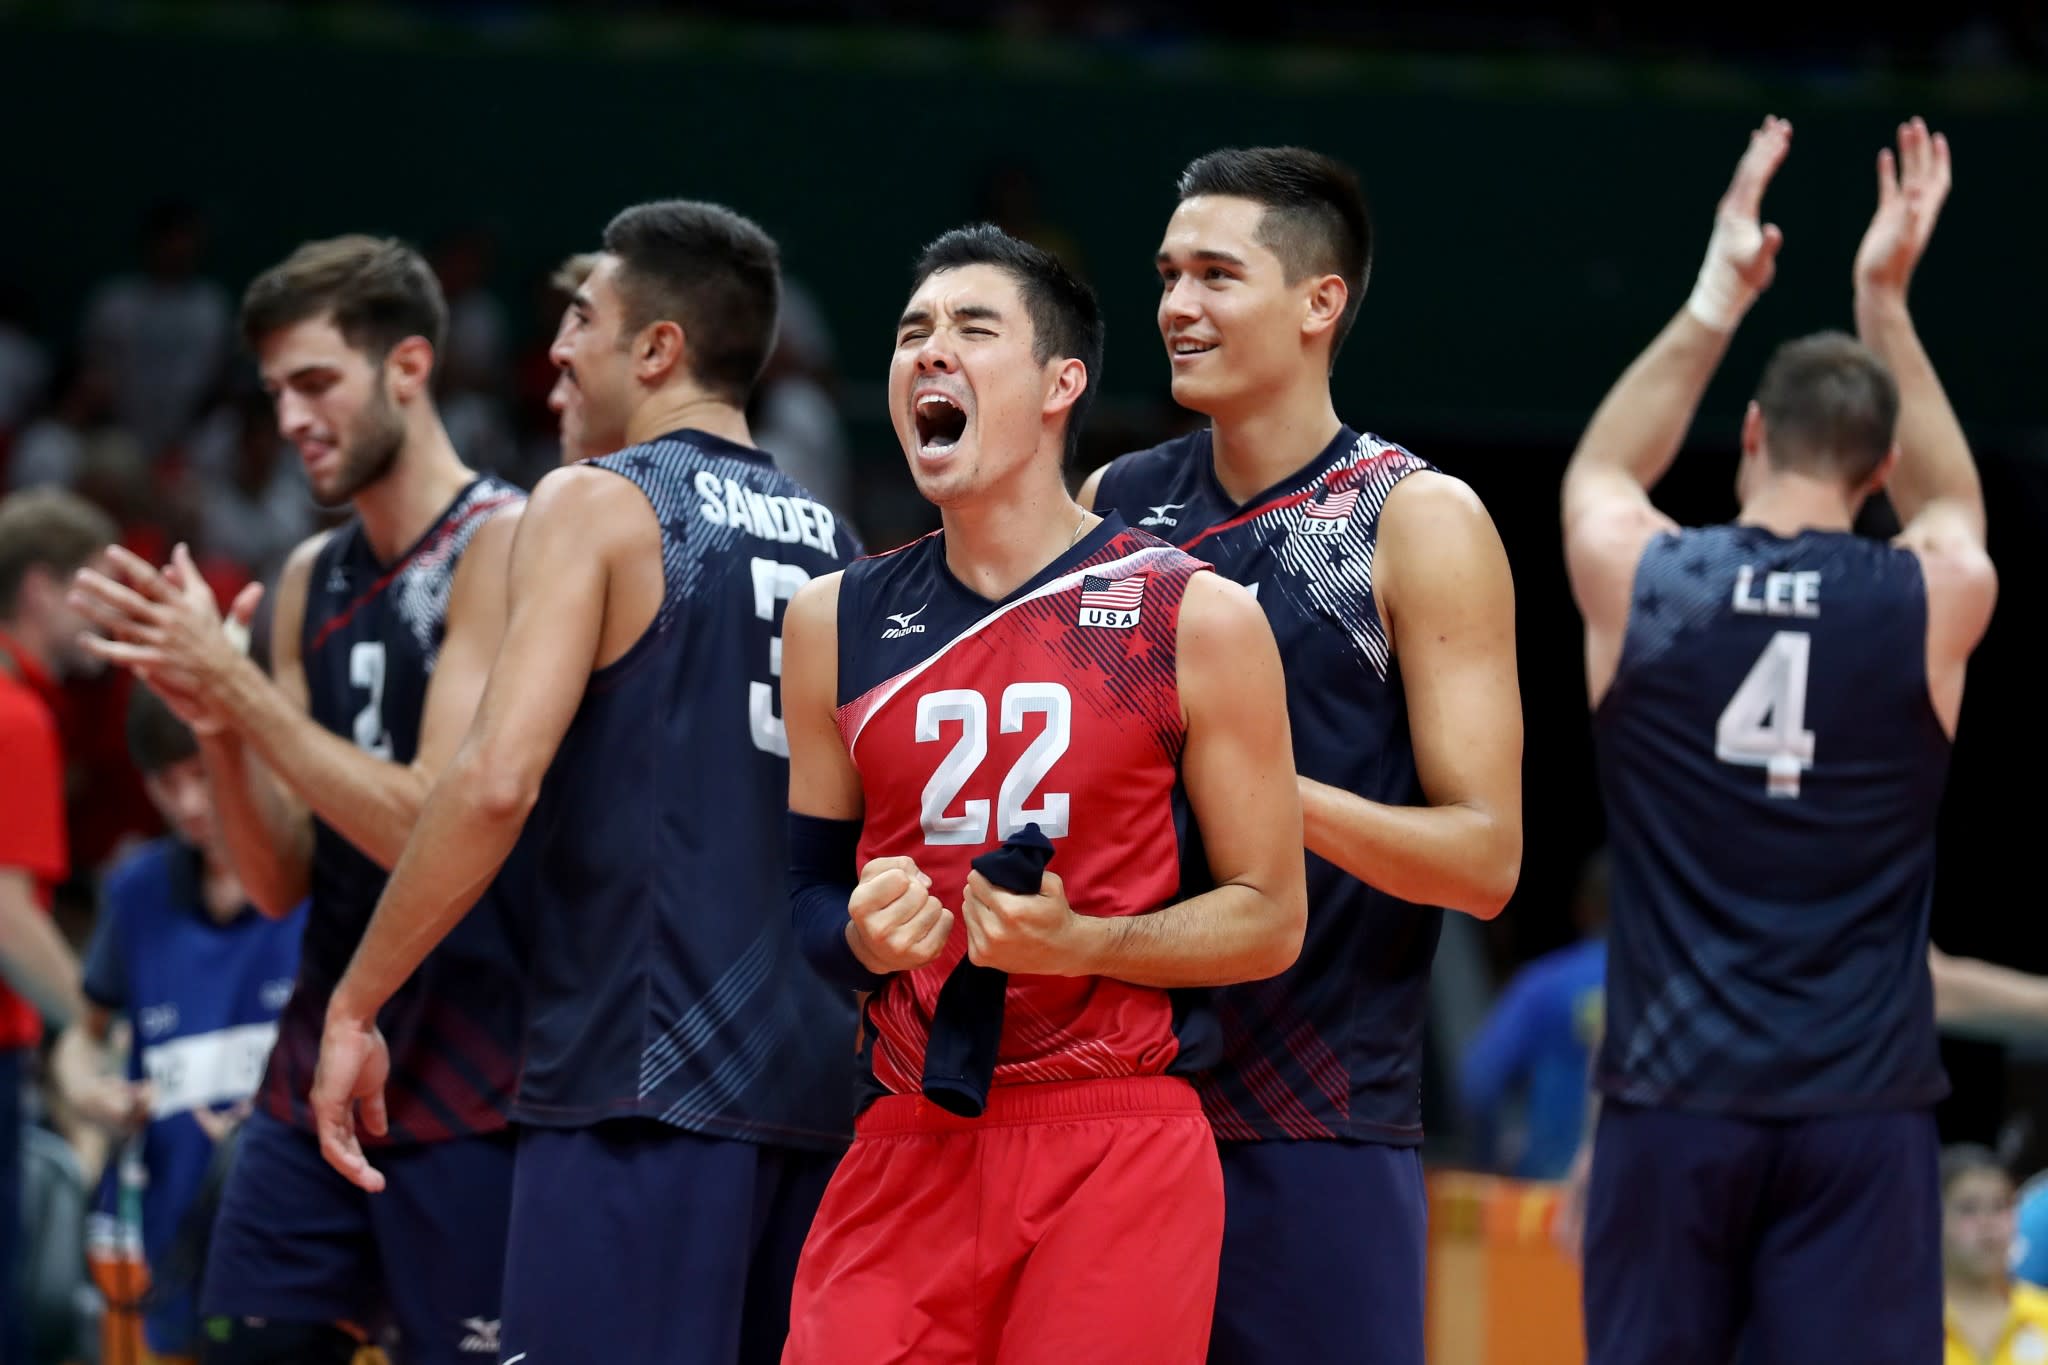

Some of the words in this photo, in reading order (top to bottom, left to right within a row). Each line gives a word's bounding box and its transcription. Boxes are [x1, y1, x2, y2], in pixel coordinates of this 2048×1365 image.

[694, 470, 839, 560] SANDER
[1301, 520, 1339, 533] USA
[1089, 610, 1132, 626] USA
[1732, 564, 1821, 619] LEE
[349, 640, 394, 762] 2
[749, 556, 813, 758] 3
[914, 682, 1072, 846] 22
[1715, 629, 1816, 800] 4
